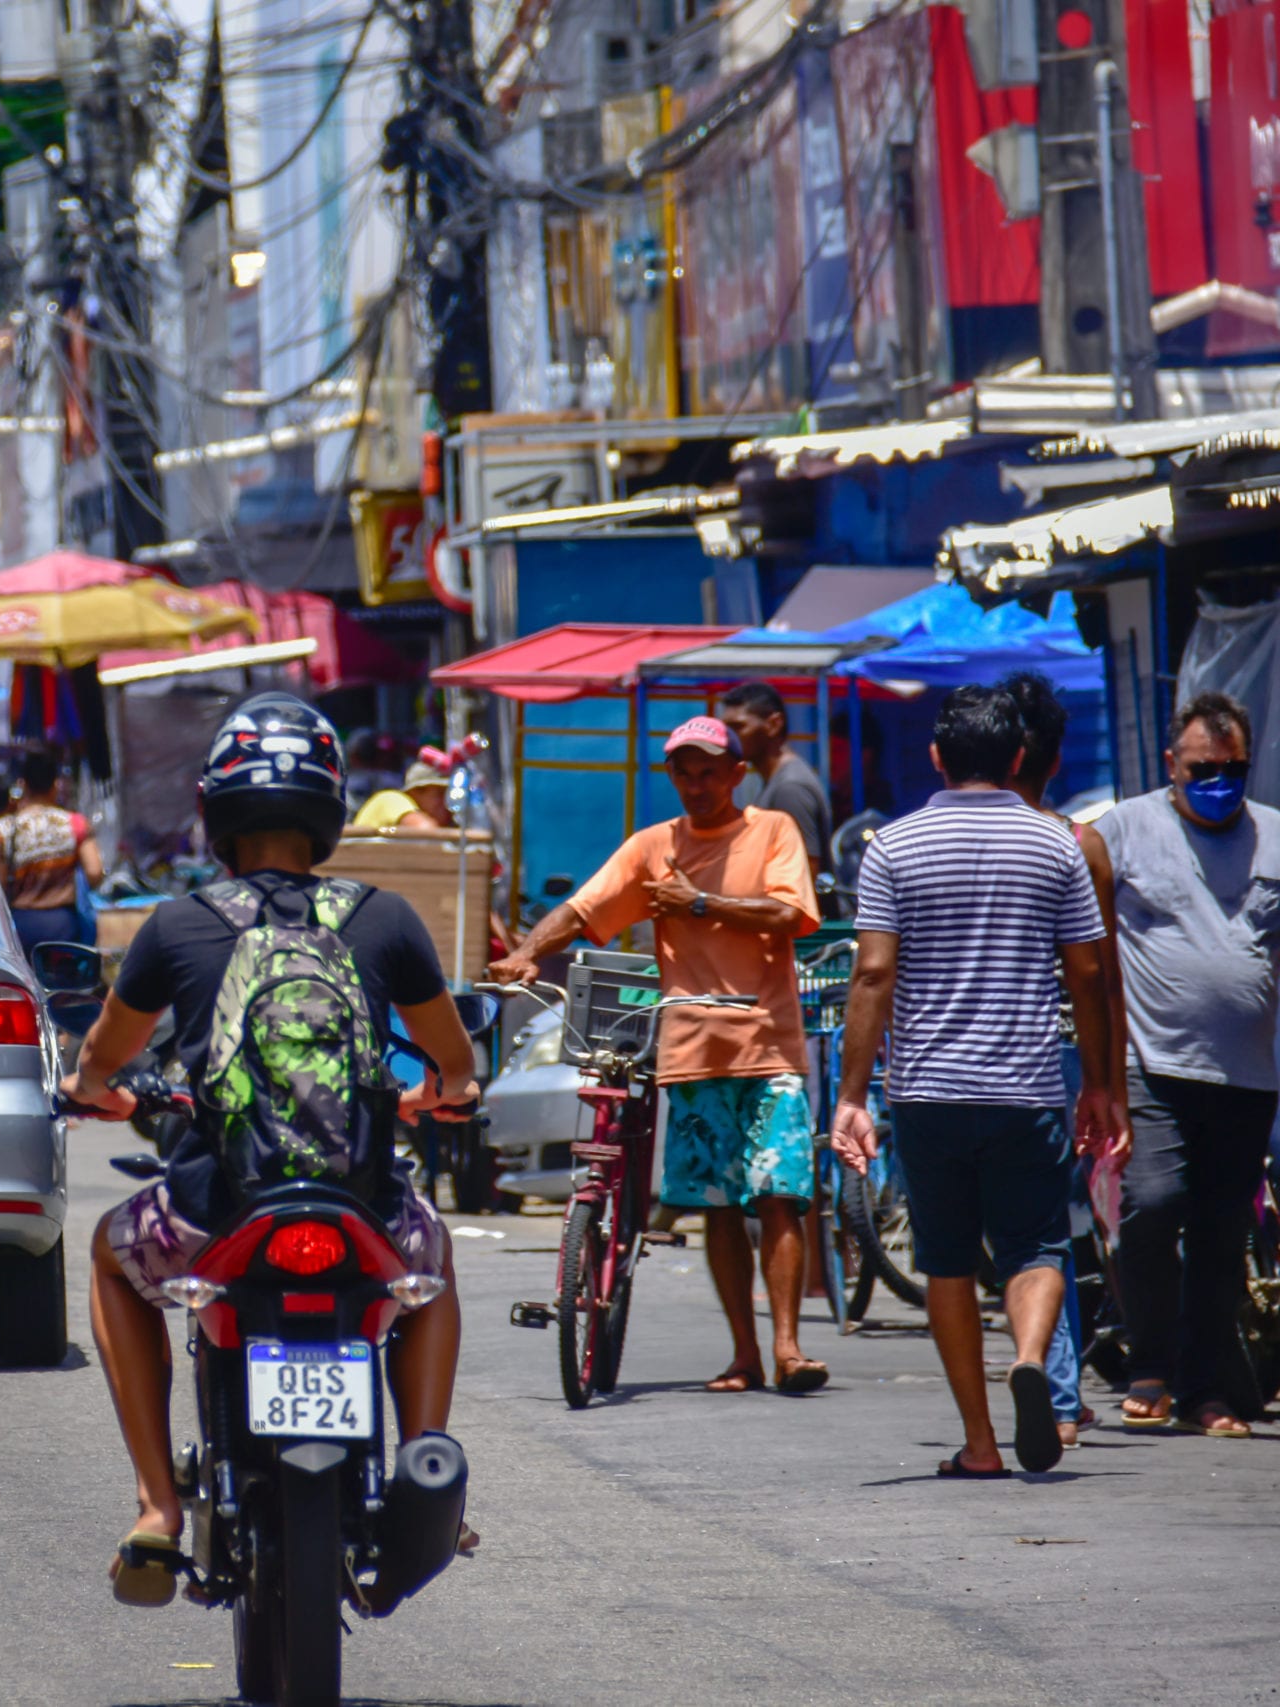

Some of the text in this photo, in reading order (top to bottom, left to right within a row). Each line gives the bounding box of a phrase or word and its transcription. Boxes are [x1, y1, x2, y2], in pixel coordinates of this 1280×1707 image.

[288, 1352, 330, 1361] BRASIL
[278, 1364, 345, 1395] QGS
[268, 1397, 357, 1429] 8F24
[254, 1420, 266, 1430] BR
